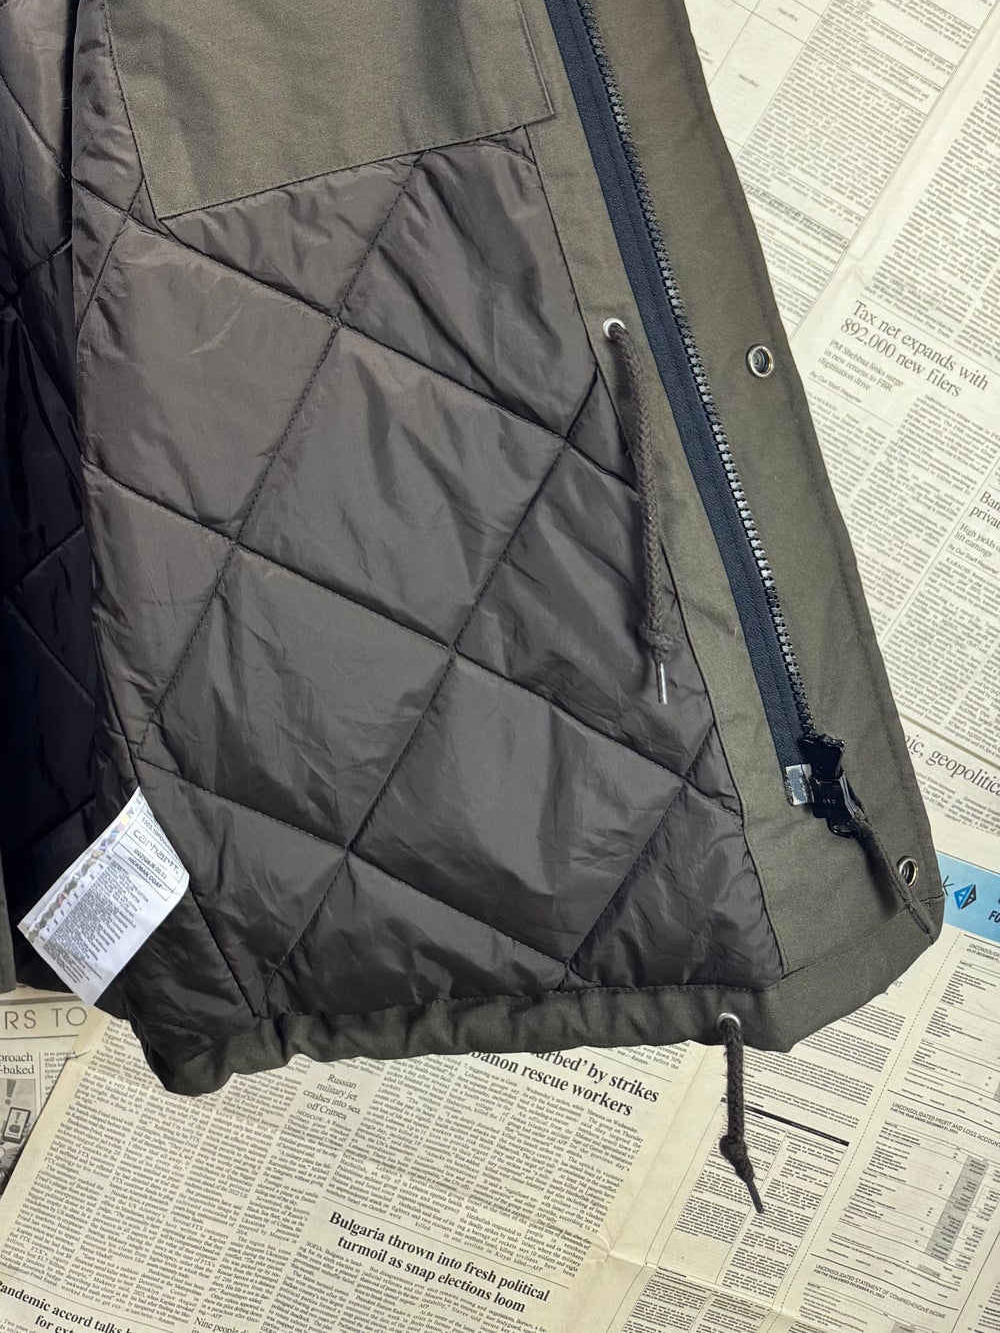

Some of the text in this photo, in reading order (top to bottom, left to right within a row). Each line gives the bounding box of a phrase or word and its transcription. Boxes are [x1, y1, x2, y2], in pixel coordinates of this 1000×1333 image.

[840, 317, 962, 397] 892,000 new filers
[852, 300, 989, 391] Tax net expands with
[50, 1006, 88, 1028] TO
[520, 1065, 633, 1116] rescue workers
[586, 1062, 660, 1103] by strikes
[328, 1211, 551, 1302] Bulgaria thrown into fresh political
[52, 1306, 94, 1324] accord
[94, 1320, 123, 1333] talks
